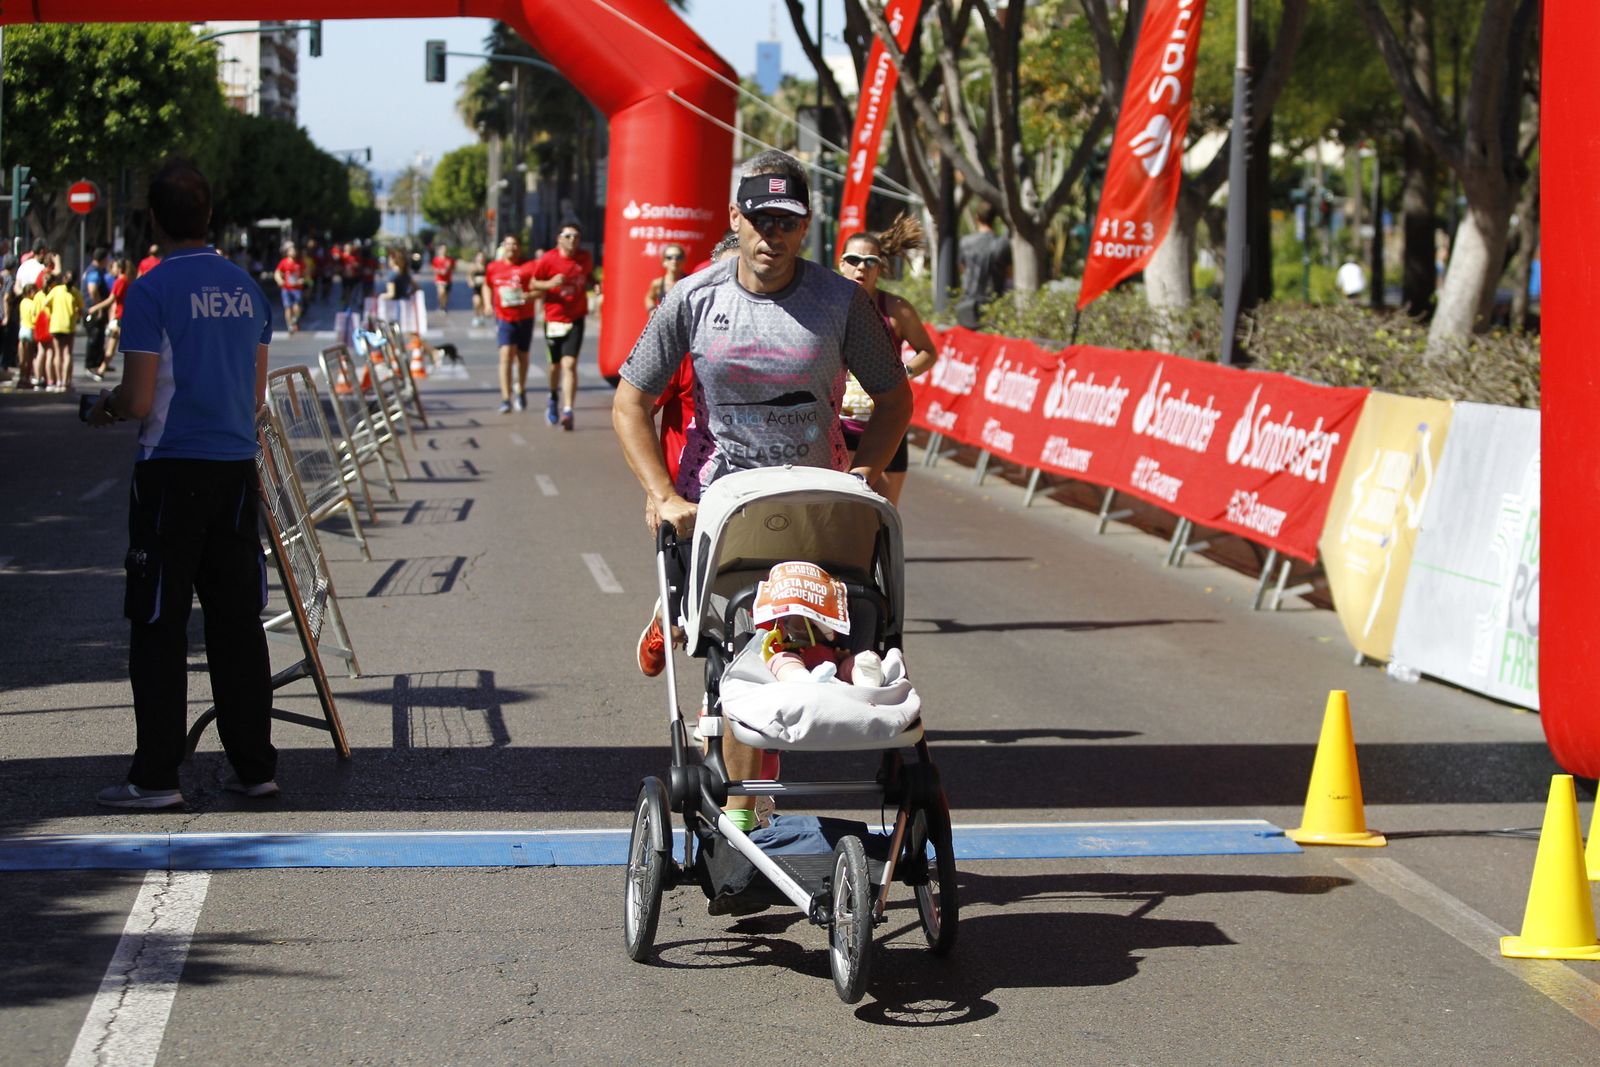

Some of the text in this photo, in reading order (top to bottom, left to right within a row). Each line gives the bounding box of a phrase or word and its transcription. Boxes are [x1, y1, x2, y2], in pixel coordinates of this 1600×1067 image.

[641, 203, 713, 220] Santander
[190, 287, 254, 319] NEXA
[1054, 369, 1130, 428] Santander
[1145, 382, 1222, 453] Santander
[1241, 403, 1340, 484] Santander
[803, 580, 827, 595] POCO
